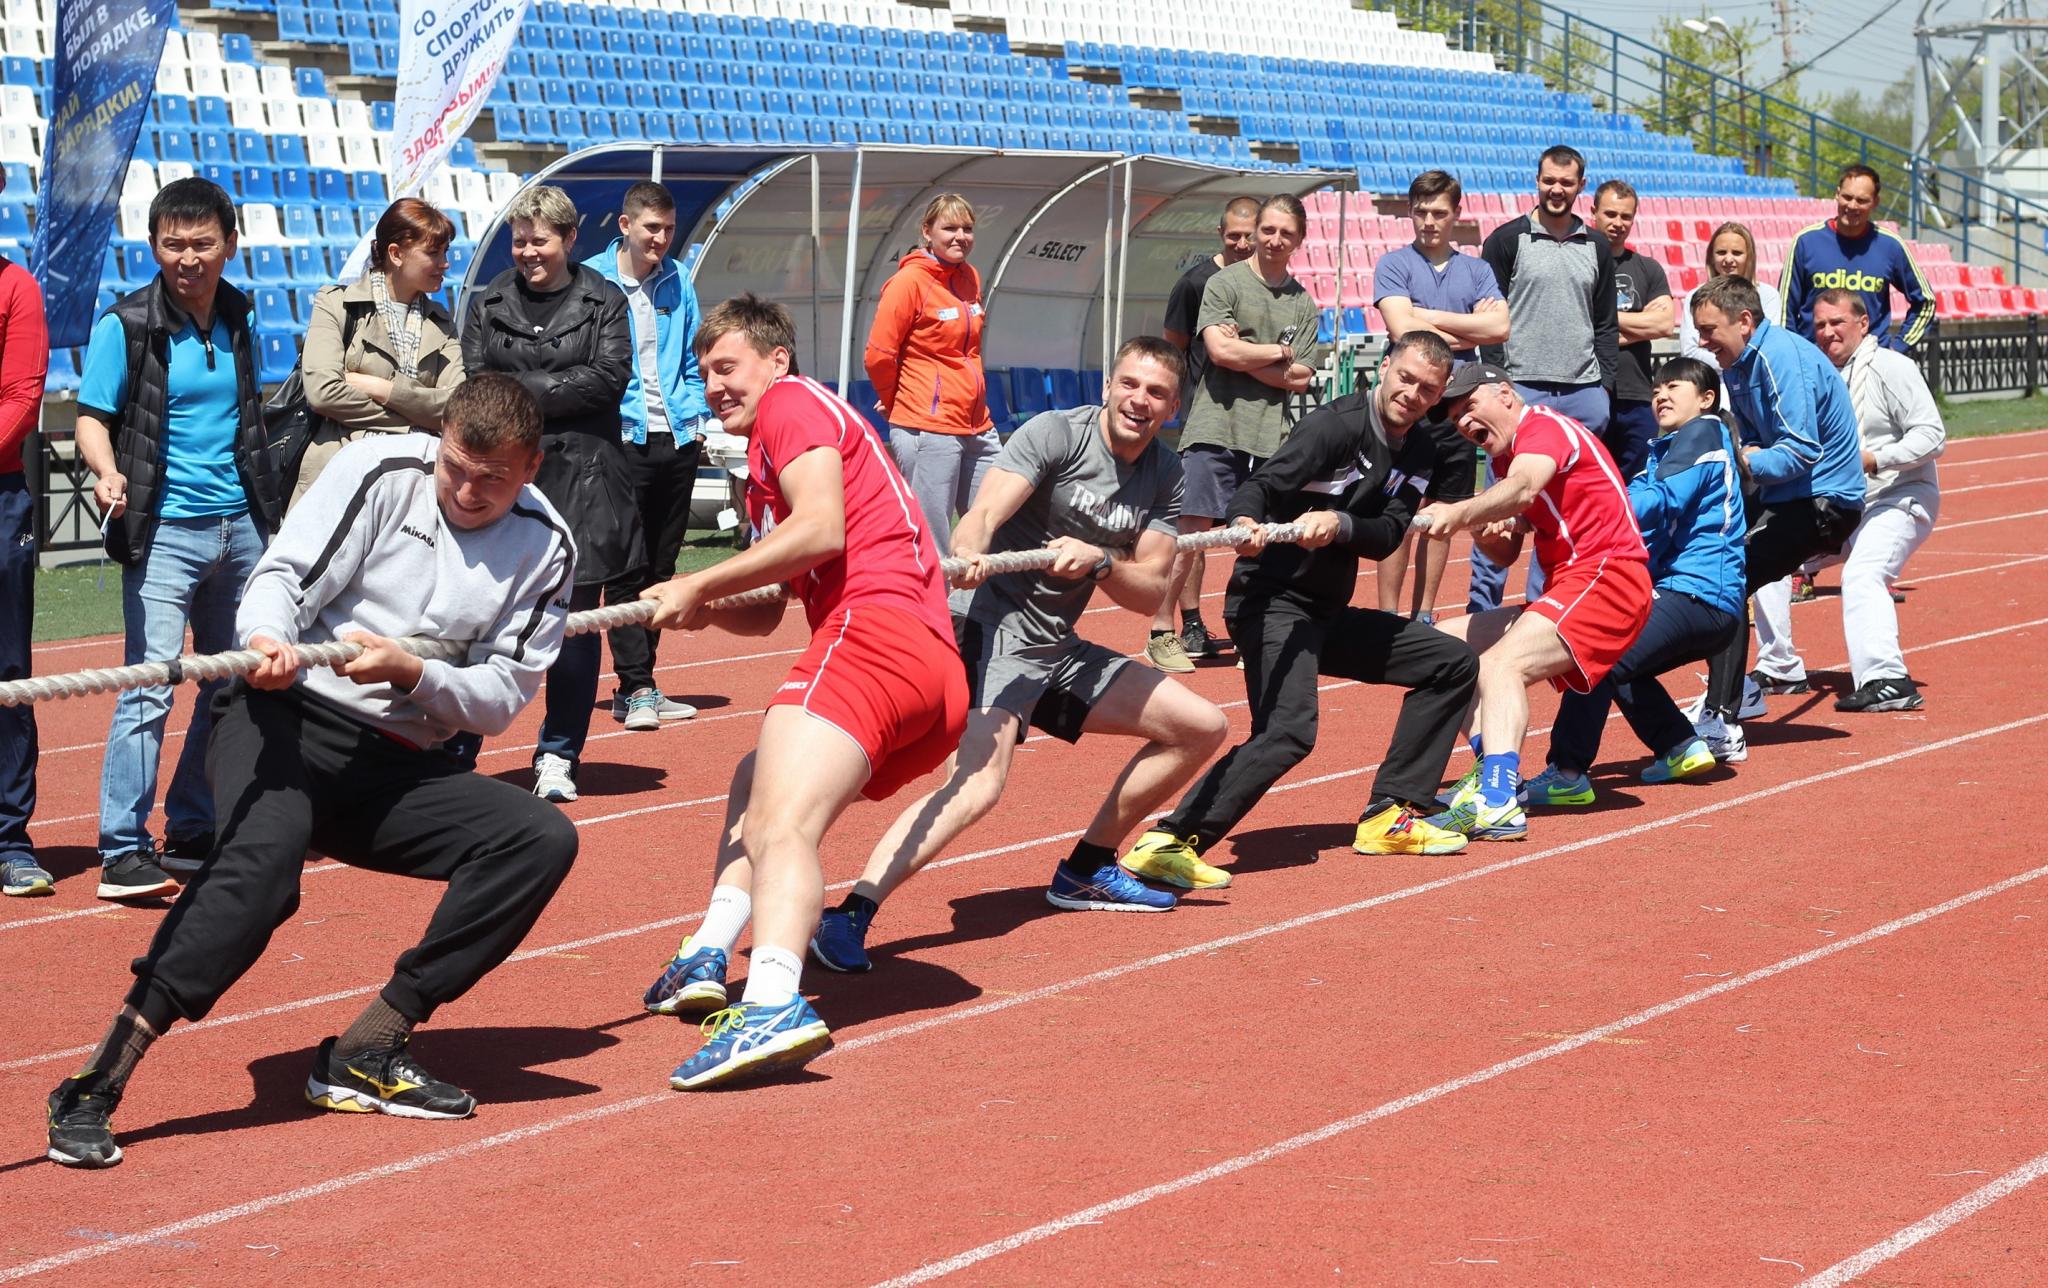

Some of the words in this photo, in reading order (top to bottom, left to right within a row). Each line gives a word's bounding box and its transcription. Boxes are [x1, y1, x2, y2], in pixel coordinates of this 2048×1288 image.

[65, 14, 96, 61] БЫЛ
[96, 4, 110, 26] В
[72, 6, 157, 83] ПОРЯДКЕ,
[413, 9, 437, 37] СО
[426, 0, 498, 57] СПОРТО
[441, 6, 515, 85] ДРУЖИТЬ
[57, 80, 143, 160] ЗАРЯДКИ!
[1038, 240, 1087, 262] SELECT
[1812, 268, 1885, 293] adidas
